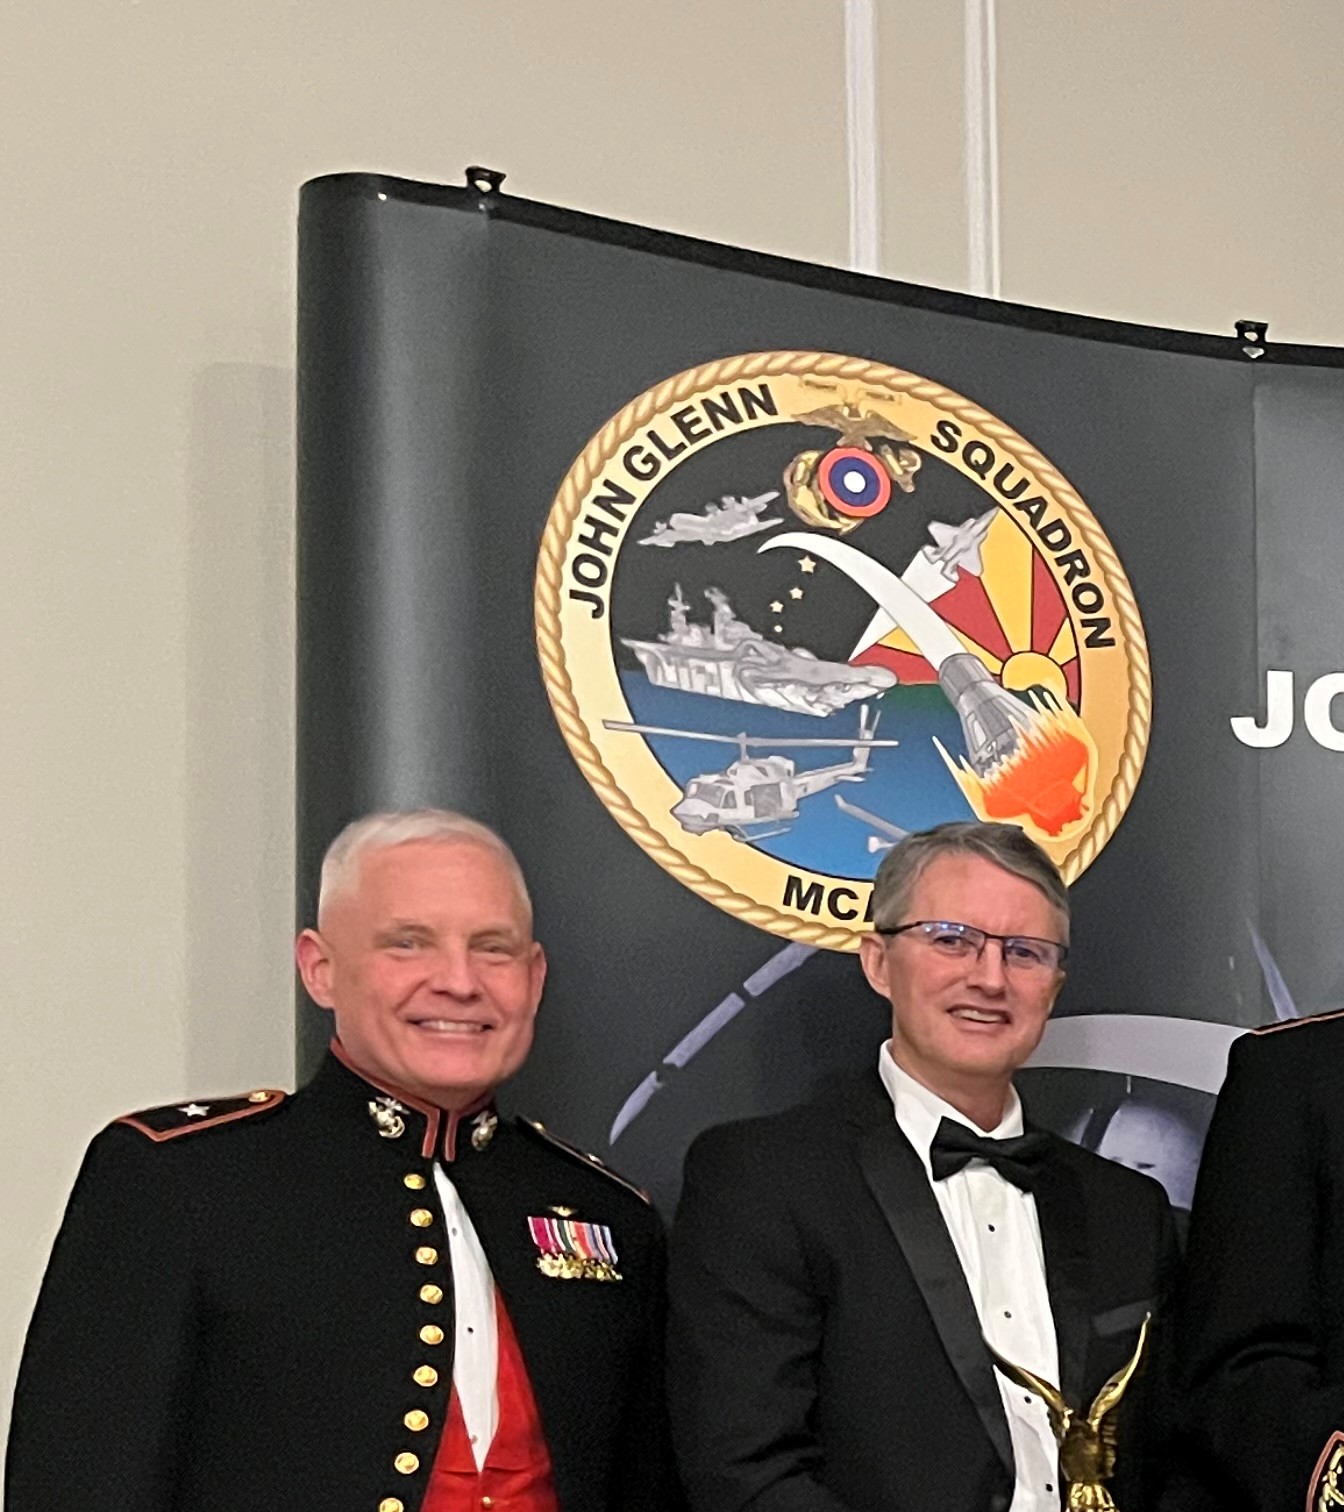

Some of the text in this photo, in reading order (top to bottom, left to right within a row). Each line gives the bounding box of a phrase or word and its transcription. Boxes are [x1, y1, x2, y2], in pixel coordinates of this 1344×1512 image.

[569, 383, 1116, 649] JOHN GLENN SQUADRON
